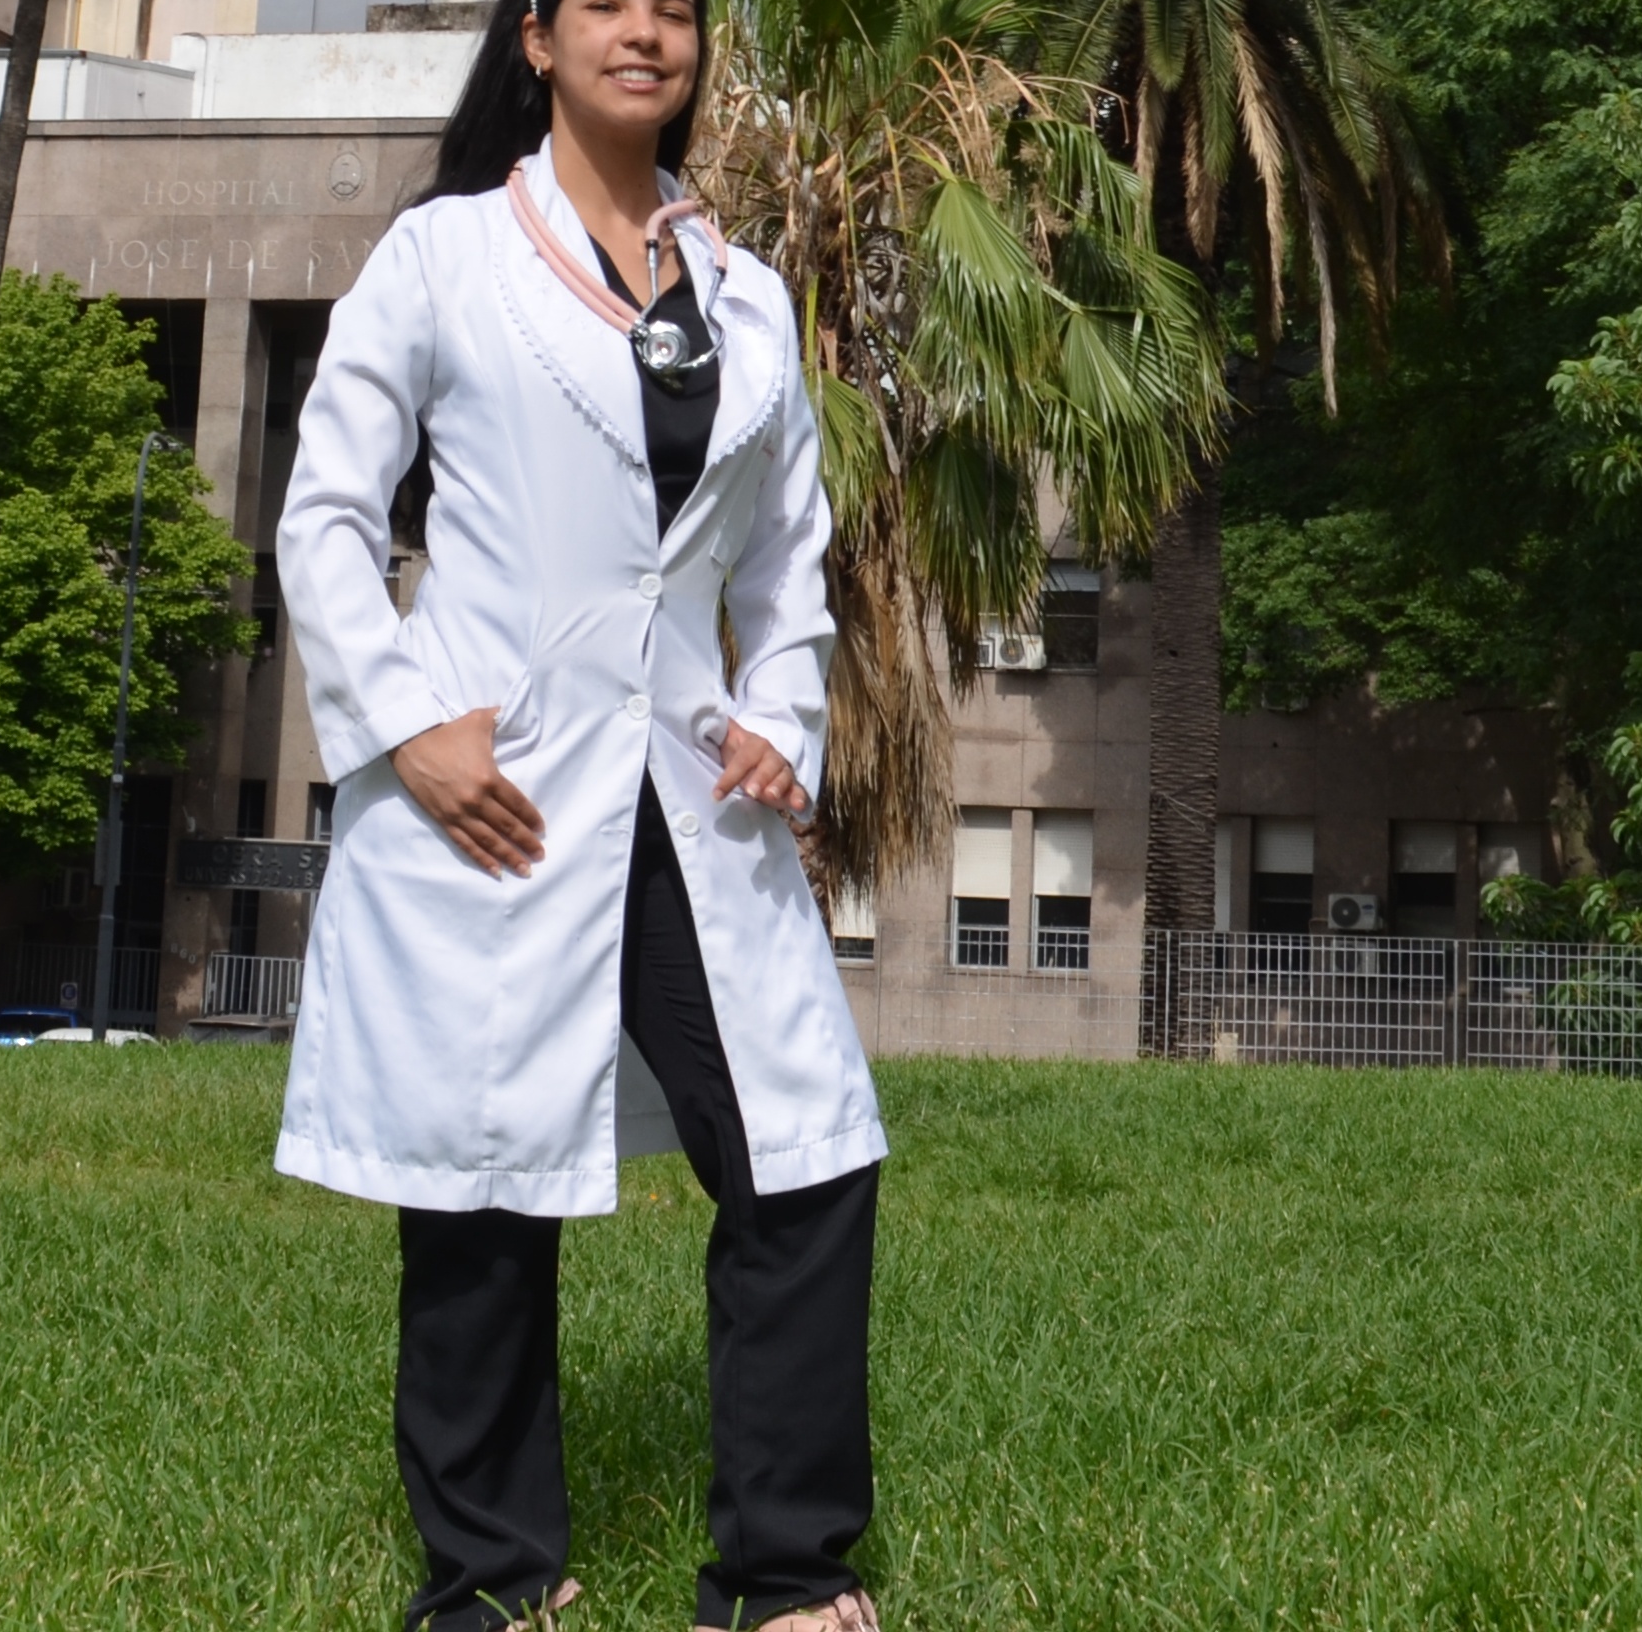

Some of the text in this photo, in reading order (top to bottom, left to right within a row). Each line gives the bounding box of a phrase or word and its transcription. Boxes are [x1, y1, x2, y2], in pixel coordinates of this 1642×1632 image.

[141, 179, 302, 206] HOSPITAL
[101, 239, 199, 270] JOSE
[228, 239, 280, 270] DE
[212, 845, 283, 869] OBRA
